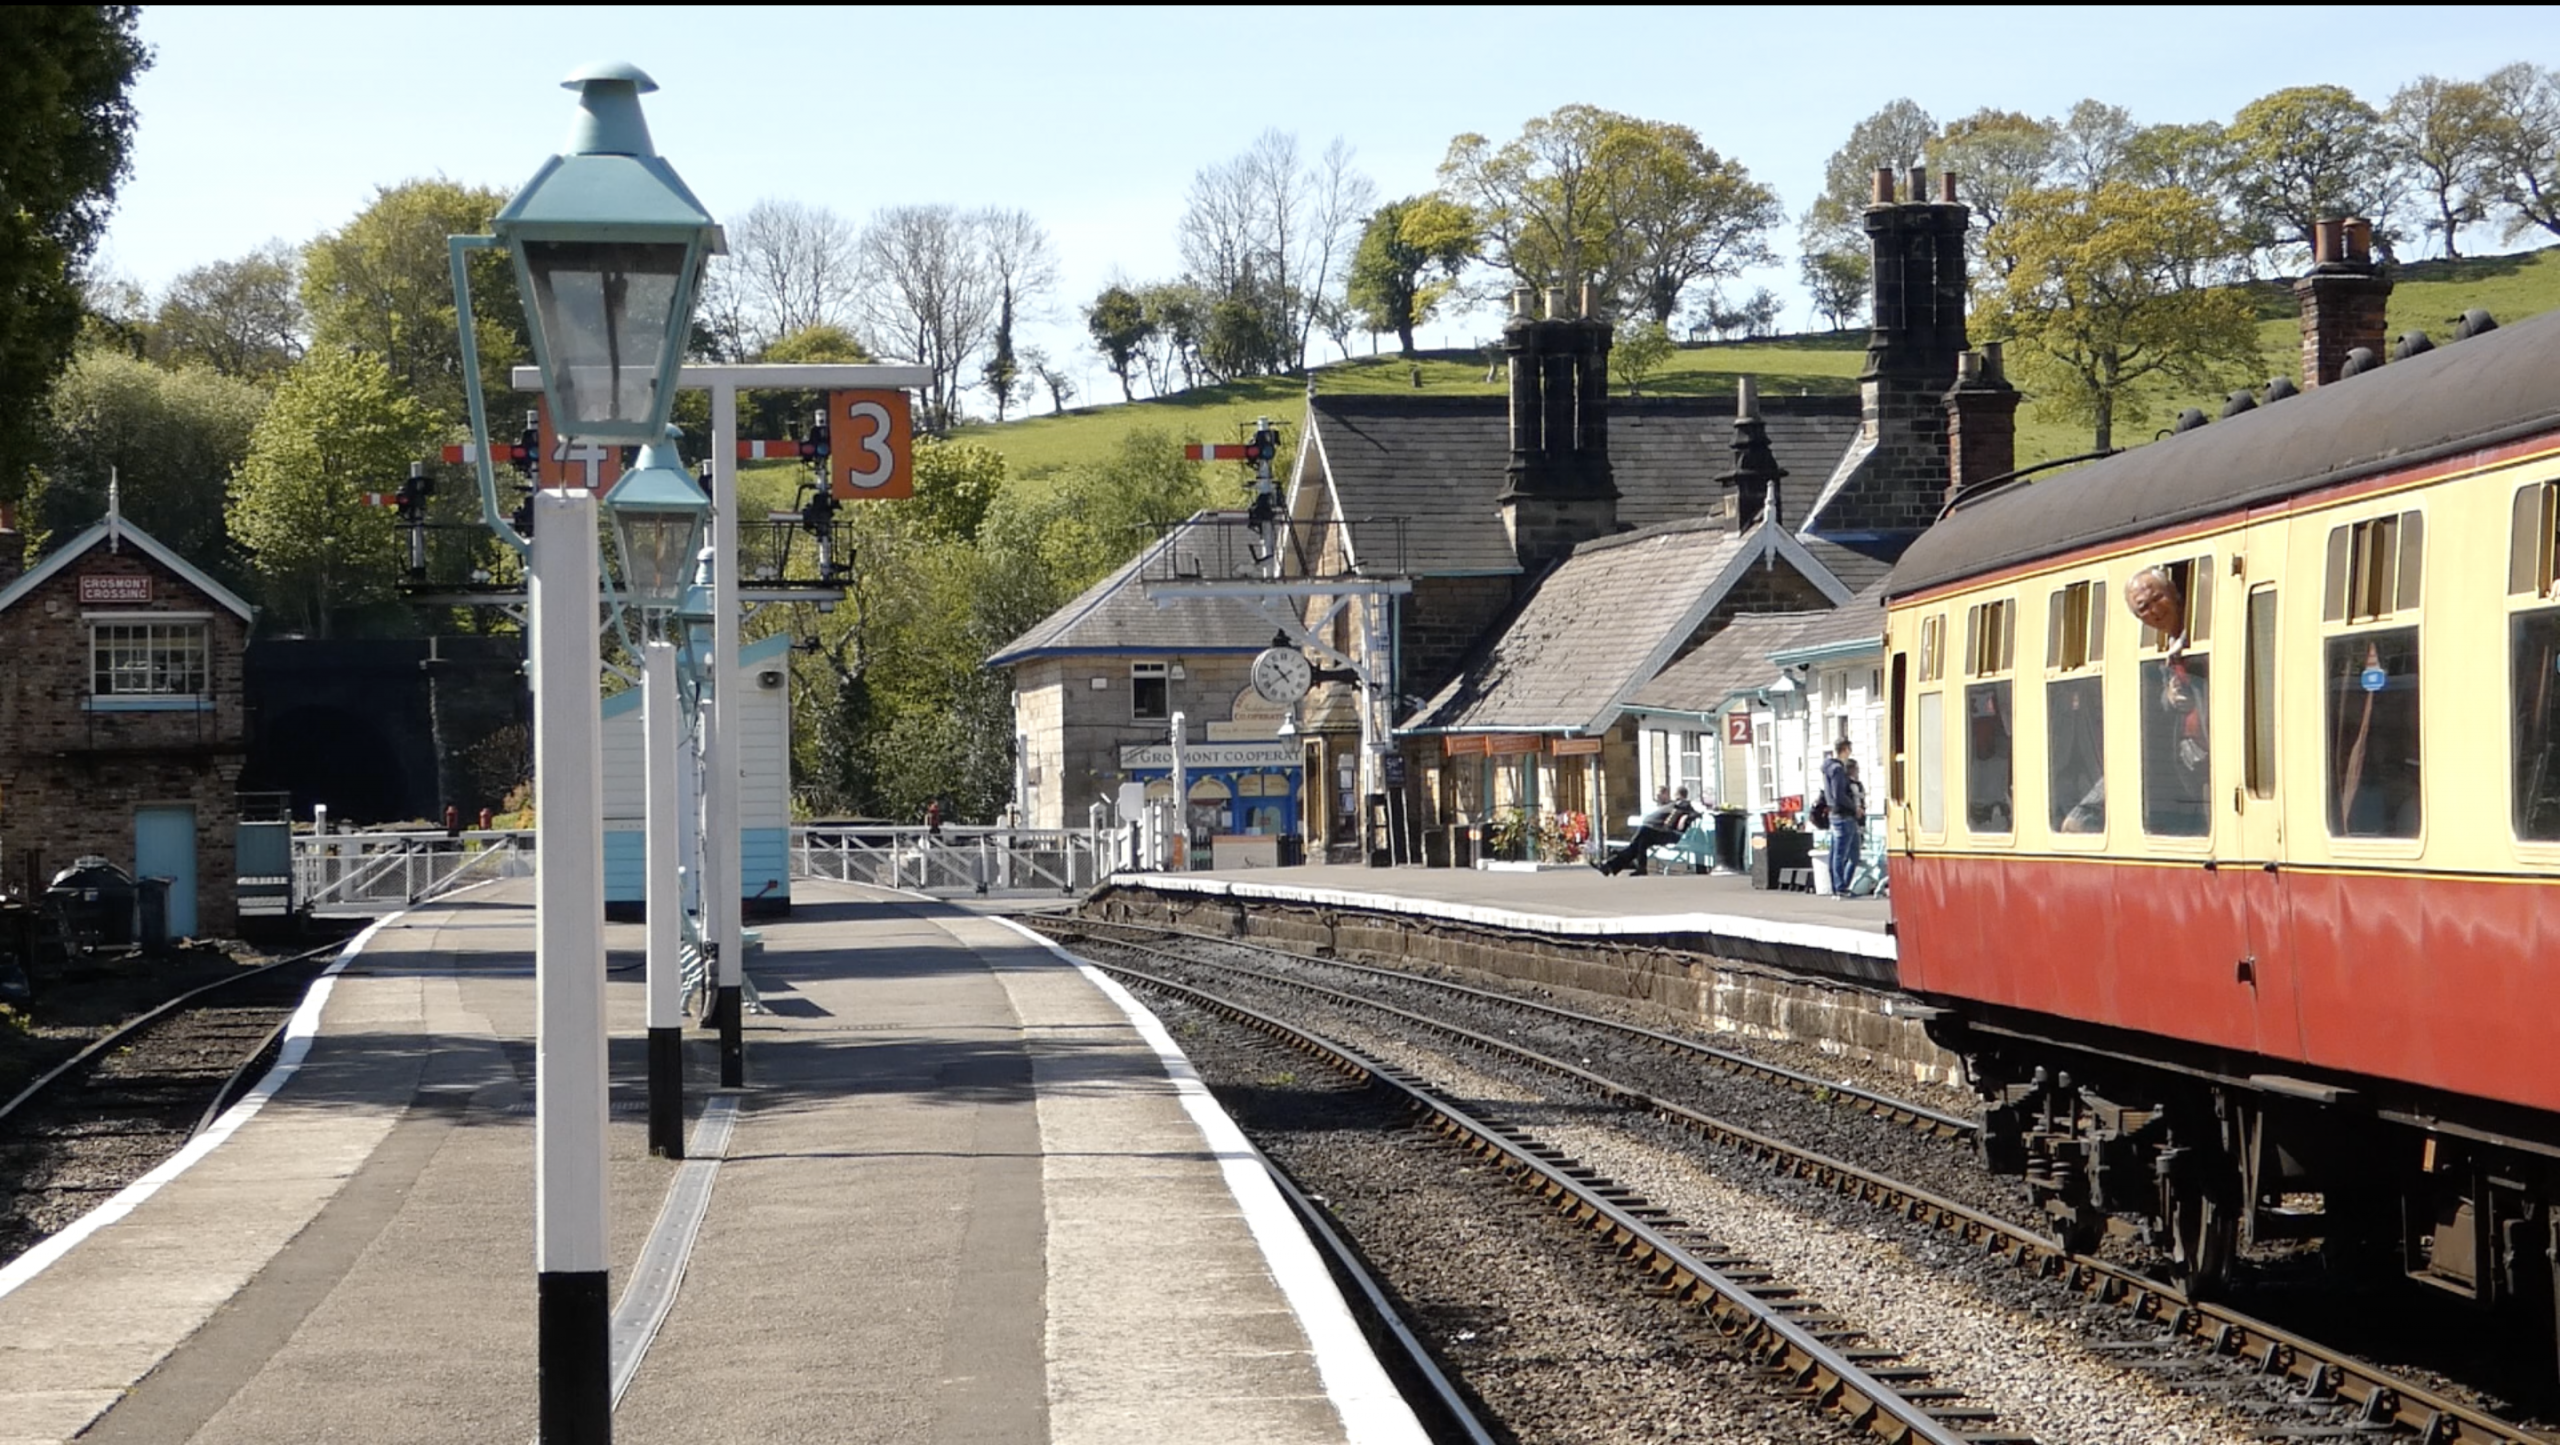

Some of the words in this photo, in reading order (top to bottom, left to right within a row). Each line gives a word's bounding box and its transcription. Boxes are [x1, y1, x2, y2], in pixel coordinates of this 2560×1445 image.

[850, 401, 895, 489] 3
[84, 579, 148, 588] GROSMONT
[85, 588, 147, 598] CROSSING
[1732, 720, 1747, 740] 2
[1140, 751, 1220, 763] GROMONT
